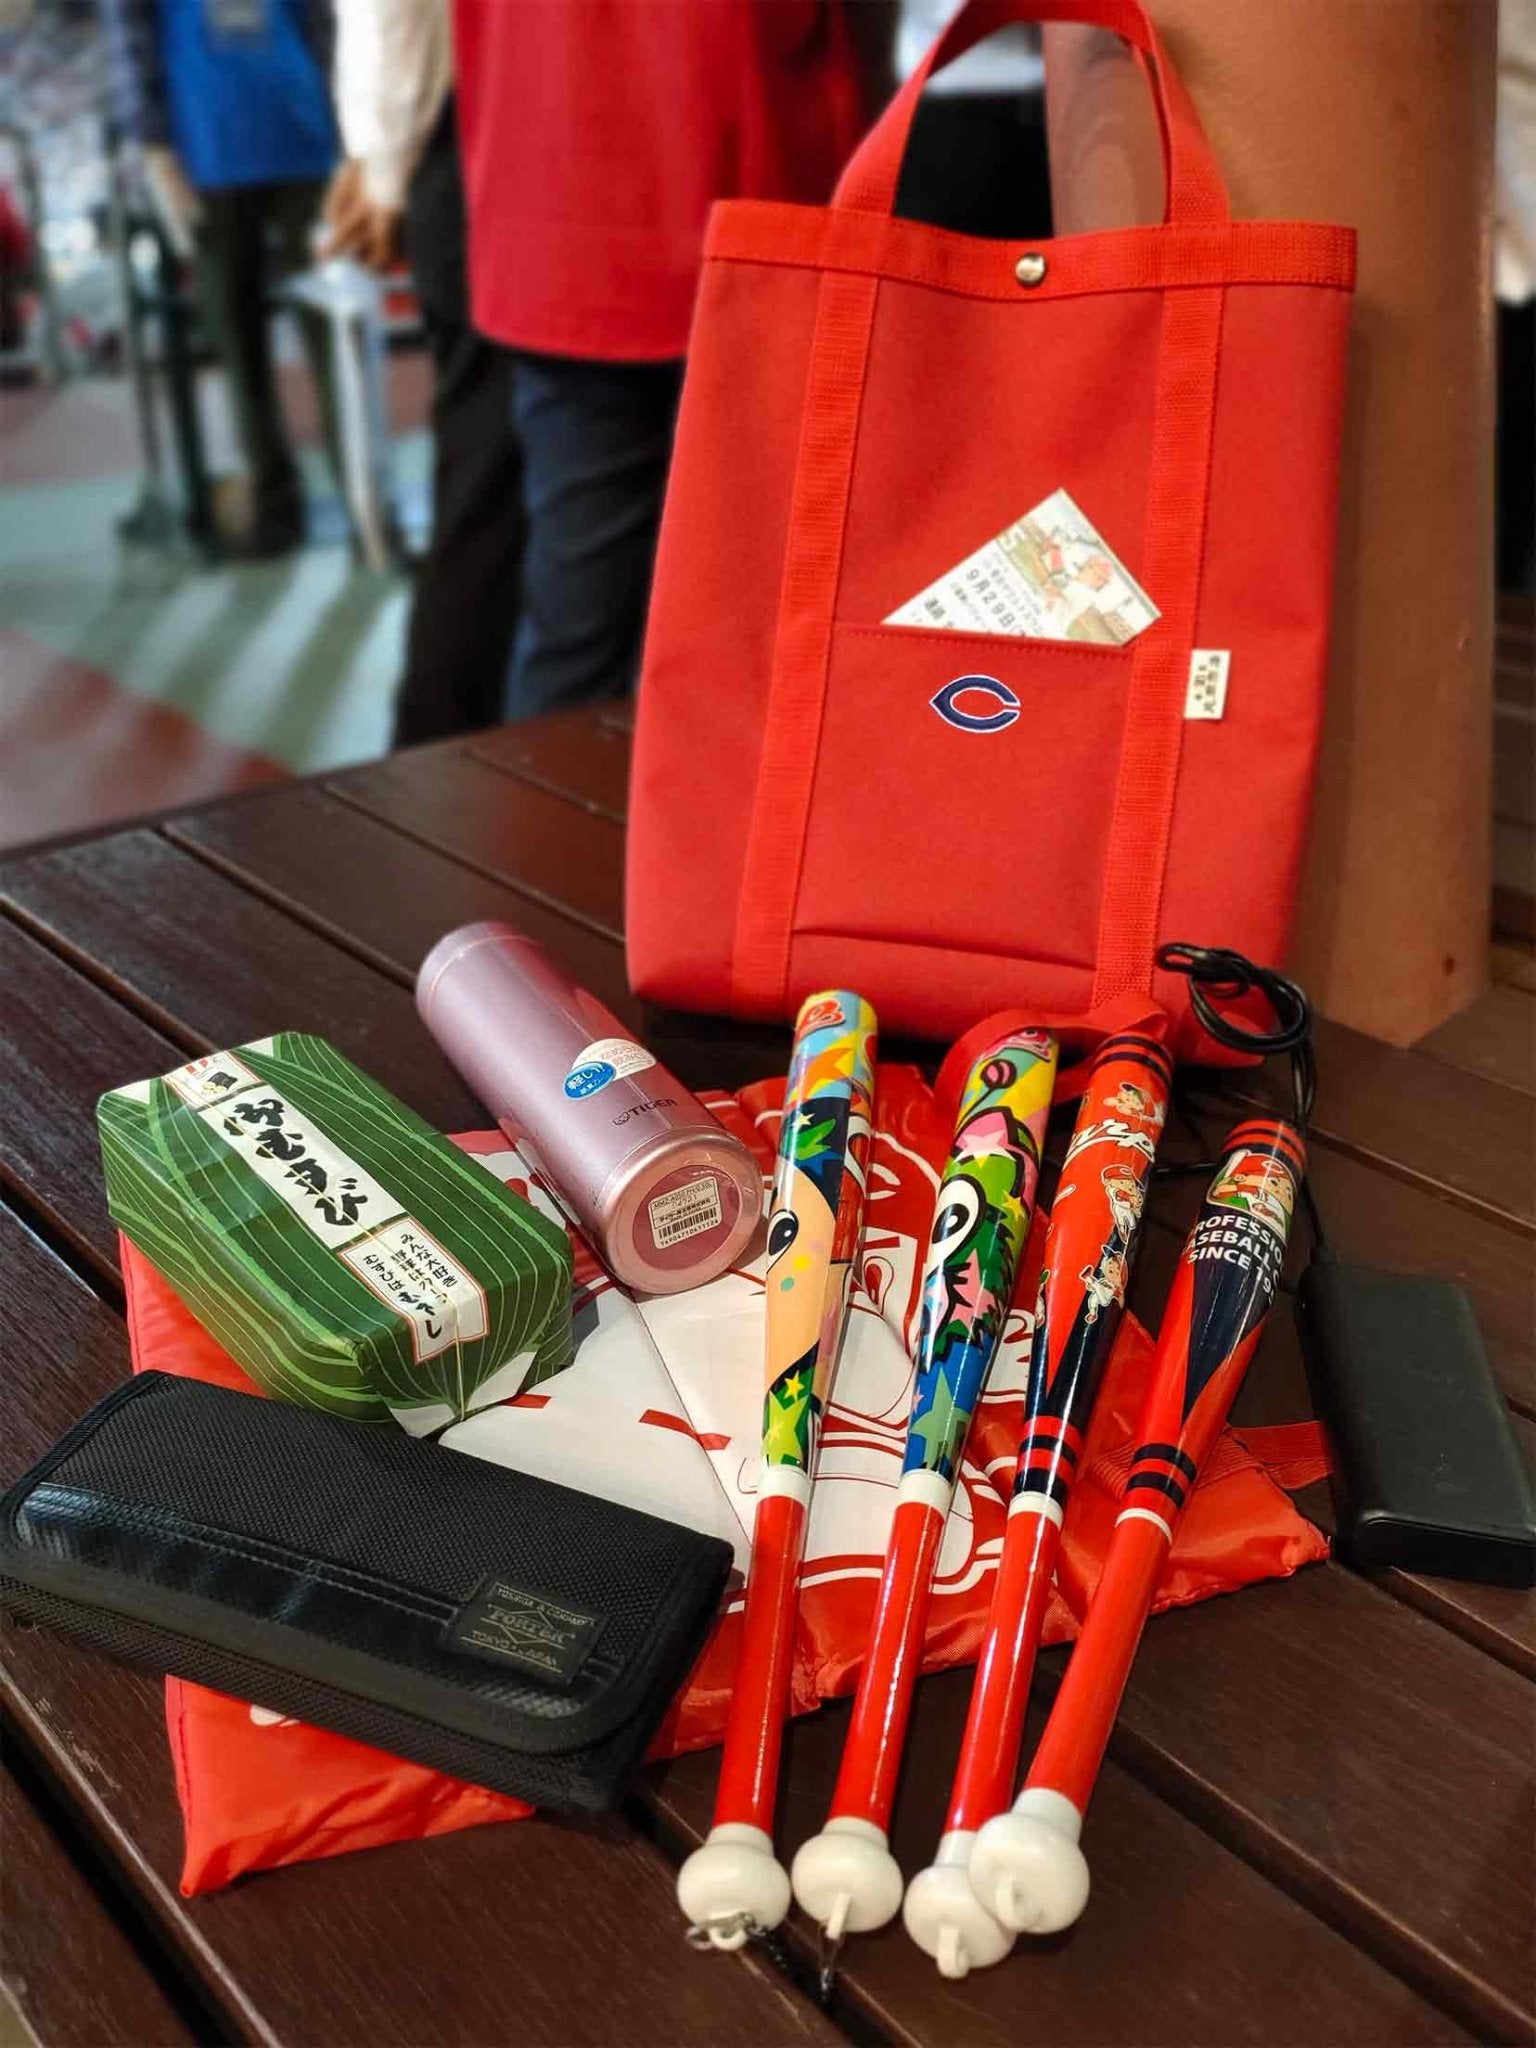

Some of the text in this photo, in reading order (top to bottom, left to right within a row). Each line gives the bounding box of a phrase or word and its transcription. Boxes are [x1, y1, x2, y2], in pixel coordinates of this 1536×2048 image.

[628, 1098, 678, 1116] TIGER
[1183, 1230, 1271, 1272] ASEBALL
[1187, 1246, 1251, 1270] SINCE
[1189, 1215, 1284, 1267] ROFESSIO
[400, 1233, 458, 1288] みんな大好き
[488, 1610, 564, 1644] PORTER
